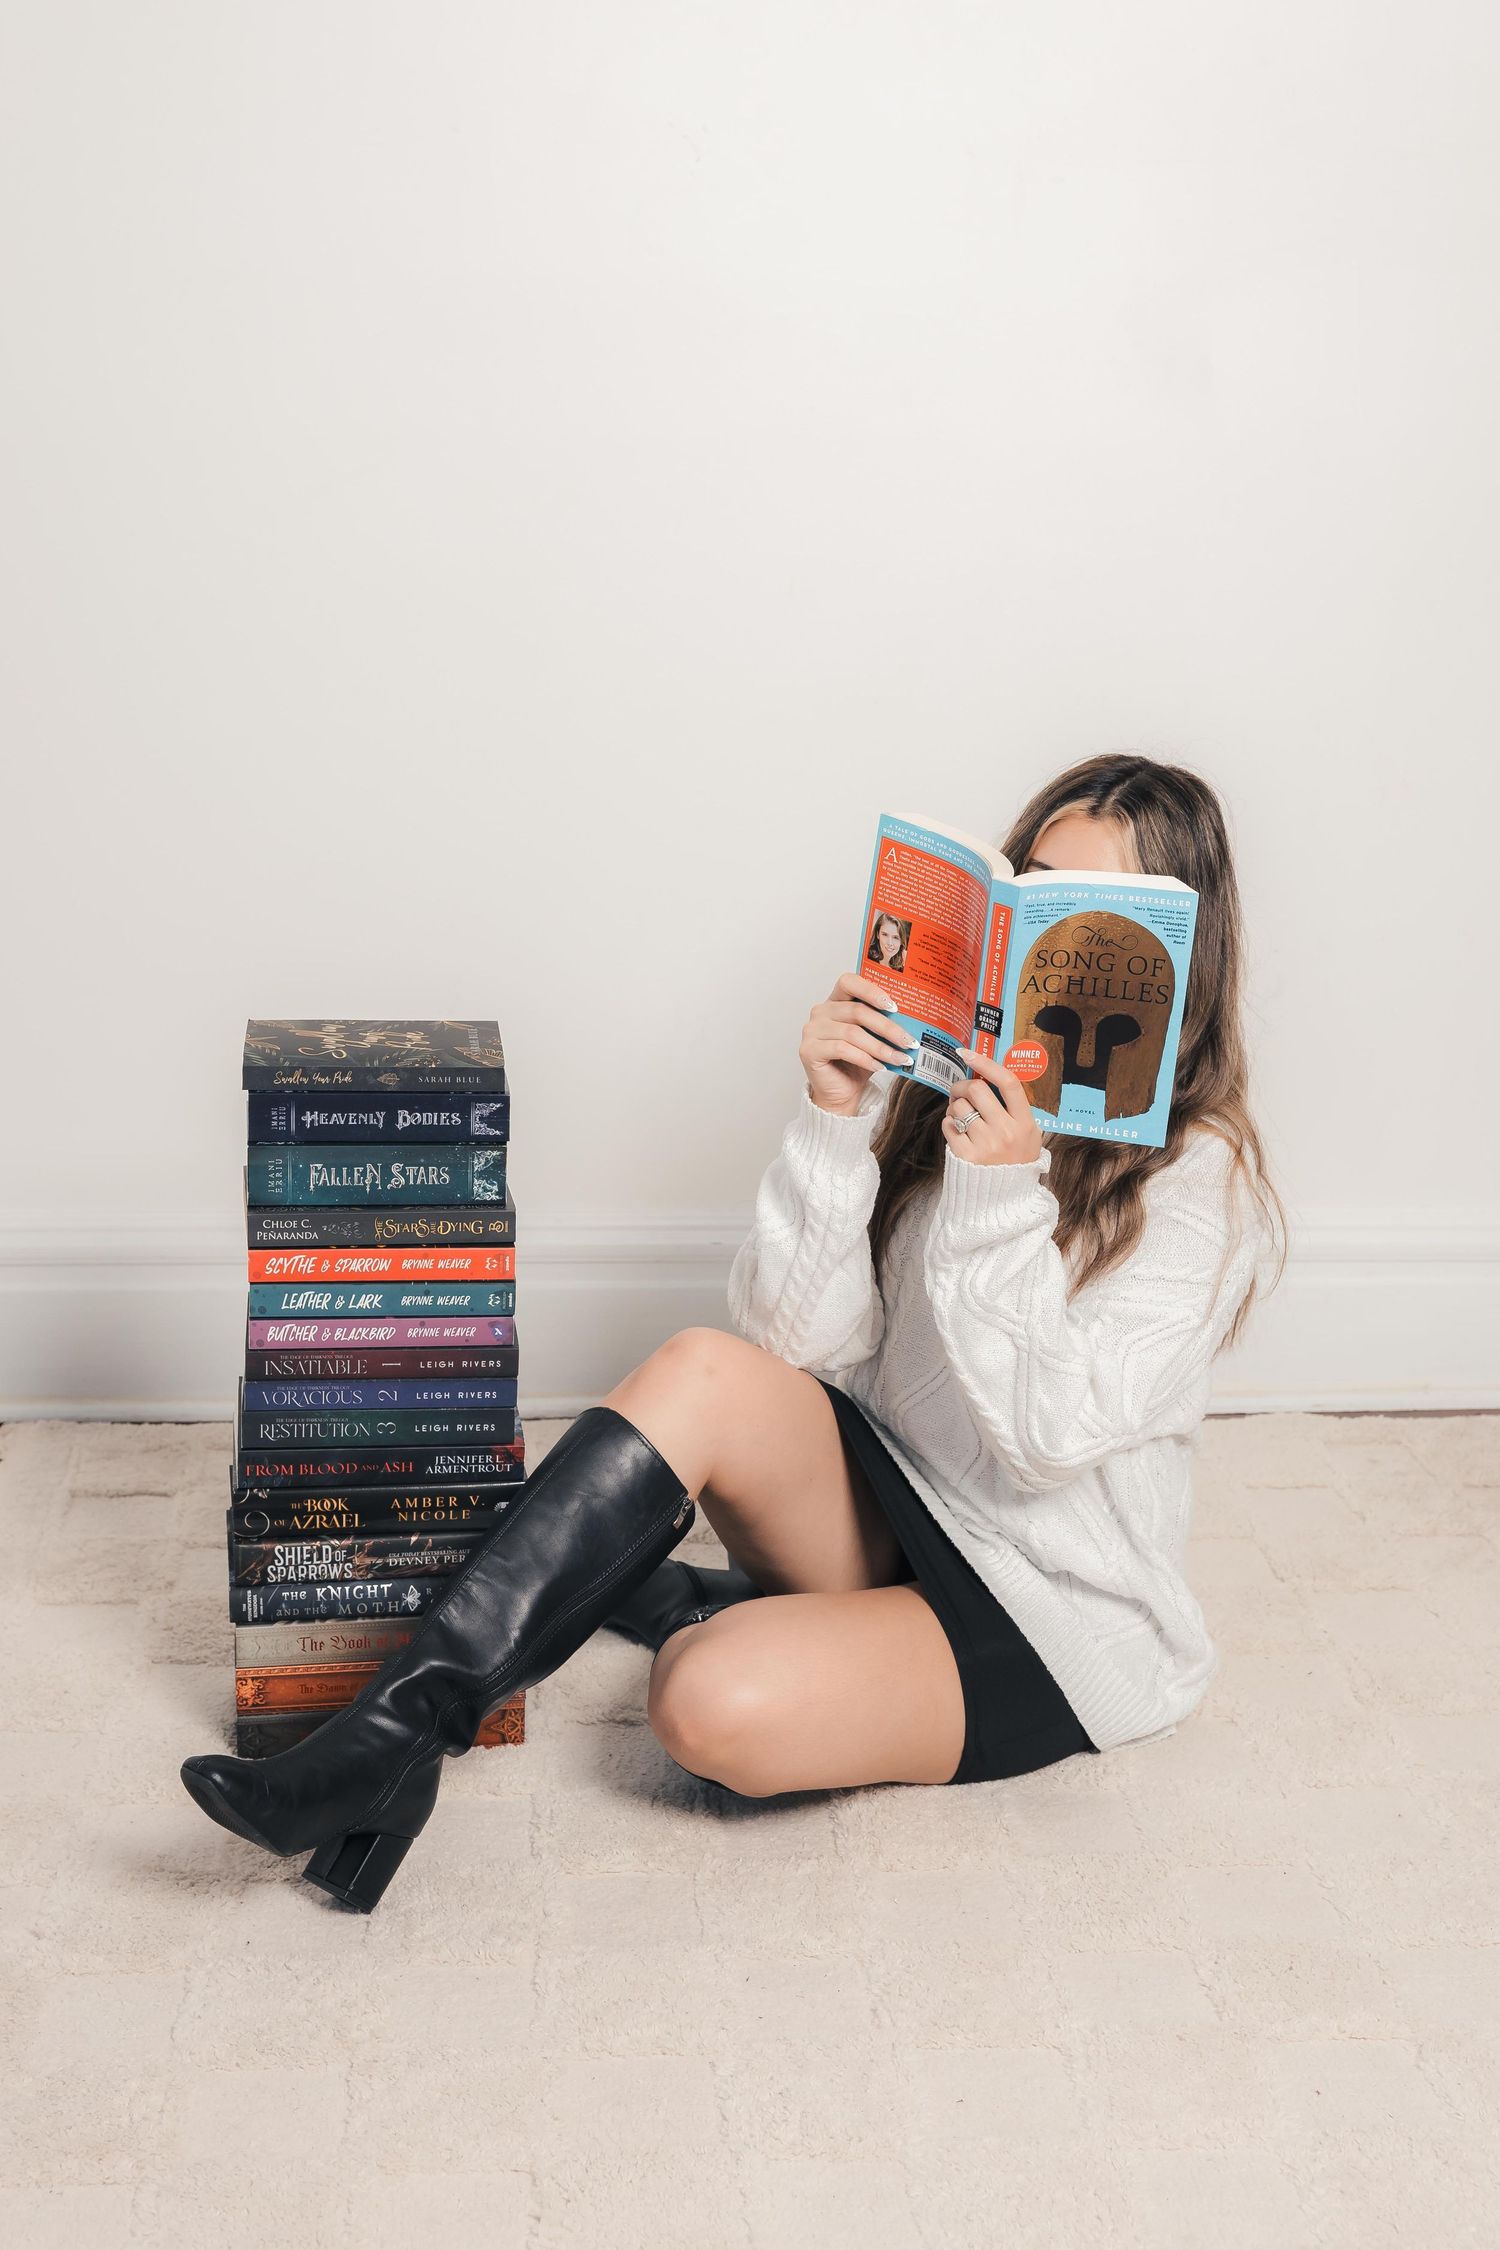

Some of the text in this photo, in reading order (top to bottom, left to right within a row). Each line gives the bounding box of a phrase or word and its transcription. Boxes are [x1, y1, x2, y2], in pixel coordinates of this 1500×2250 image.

[895, 825, 908, 834] TALE
[920, 834, 935, 844] GODS
[936, 841, 947, 850] AND
[908, 837, 936, 852] IMMORTAL
[938, 849, 952, 859] FAME
[1038, 891, 1059, 899] NEW
[1063, 891, 1089, 899] YORK
[1095, 893, 1124, 901] TIMES
[1128, 895, 1191, 907] BESTSELLER
[995, 929, 1003, 950] SONG
[1071, 925, 1139, 951] The
[994, 953, 1001, 963] OF
[1035, 949, 1166, 977] SONG OF
[989, 965, 998, 1001] ACHILLES
[1020, 974, 1171, 1005] ACHILLES
[980, 1006, 1000, 1018] WINNER
[979, 1015, 999, 1027] ORANGE
[980, 1021, 995, 1032] PRIZE
[1011, 1049, 1041, 1059] WINNER
[273, 1068, 353, 1085] Swallow Your Pride
[456, 1076, 481, 1084] BLUE
[278, 1106, 287, 1131] ERRIU
[301, 1109, 462, 1131] HEAVENLY BODIES
[1089, 1125, 1138, 1139] MILLER
[275, 1158, 283, 1193] ERRIU
[309, 1162, 451, 1195] FALLEN STARS
[262, 1219, 312, 1229] CHLOE C.
[383, 1218, 430, 1238] STARS
[437, 1219, 484, 1235] DYING
[256, 1230, 319, 1241] PEÑARANDA
[265, 1255, 472, 1275] SCYTHE & SPARROW BRYNNE WEAVER
[281, 1291, 471, 1310] LEATHER & LARK BRYNNE WEAVER
[267, 1323, 477, 1342] BUTCHER & BLACKBIRD BRYNNE WEAVER
[265, 1360, 502, 1376] INSATIABLE LEIGH RIVERS
[262, 1390, 497, 1408] VORACIOUS 2 LEIGH RIVERS
[260, 1421, 496, 1442] RESTITUTION 3 LEIGH RIVERS
[435, 1454, 505, 1465] JENNIFER L.
[245, 1463, 294, 1477] FROM
[299, 1462, 358, 1476] BLOOD
[380, 1461, 414, 1473] ASH
[425, 1463, 513, 1475] ARMENTROUT
[303, 1497, 350, 1512] BOOK
[390, 1495, 485, 1509] AMBER V.
[274, 1513, 366, 1530] OF AZRAEL
[398, 1509, 471, 1522] NICOLE
[274, 1545, 348, 1567] SHIELD OF
[388, 1556, 440, 1567] DEVNEY
[267, 1563, 353, 1583] SPARROWS
[282, 1583, 393, 1602] THE KNIGHT
[337, 1601, 399, 1615] MOTH
[297, 1636, 325, 1653] The
[330, 1635, 372, 1651] Book
[298, 1682, 348, 1695] The Dawn
